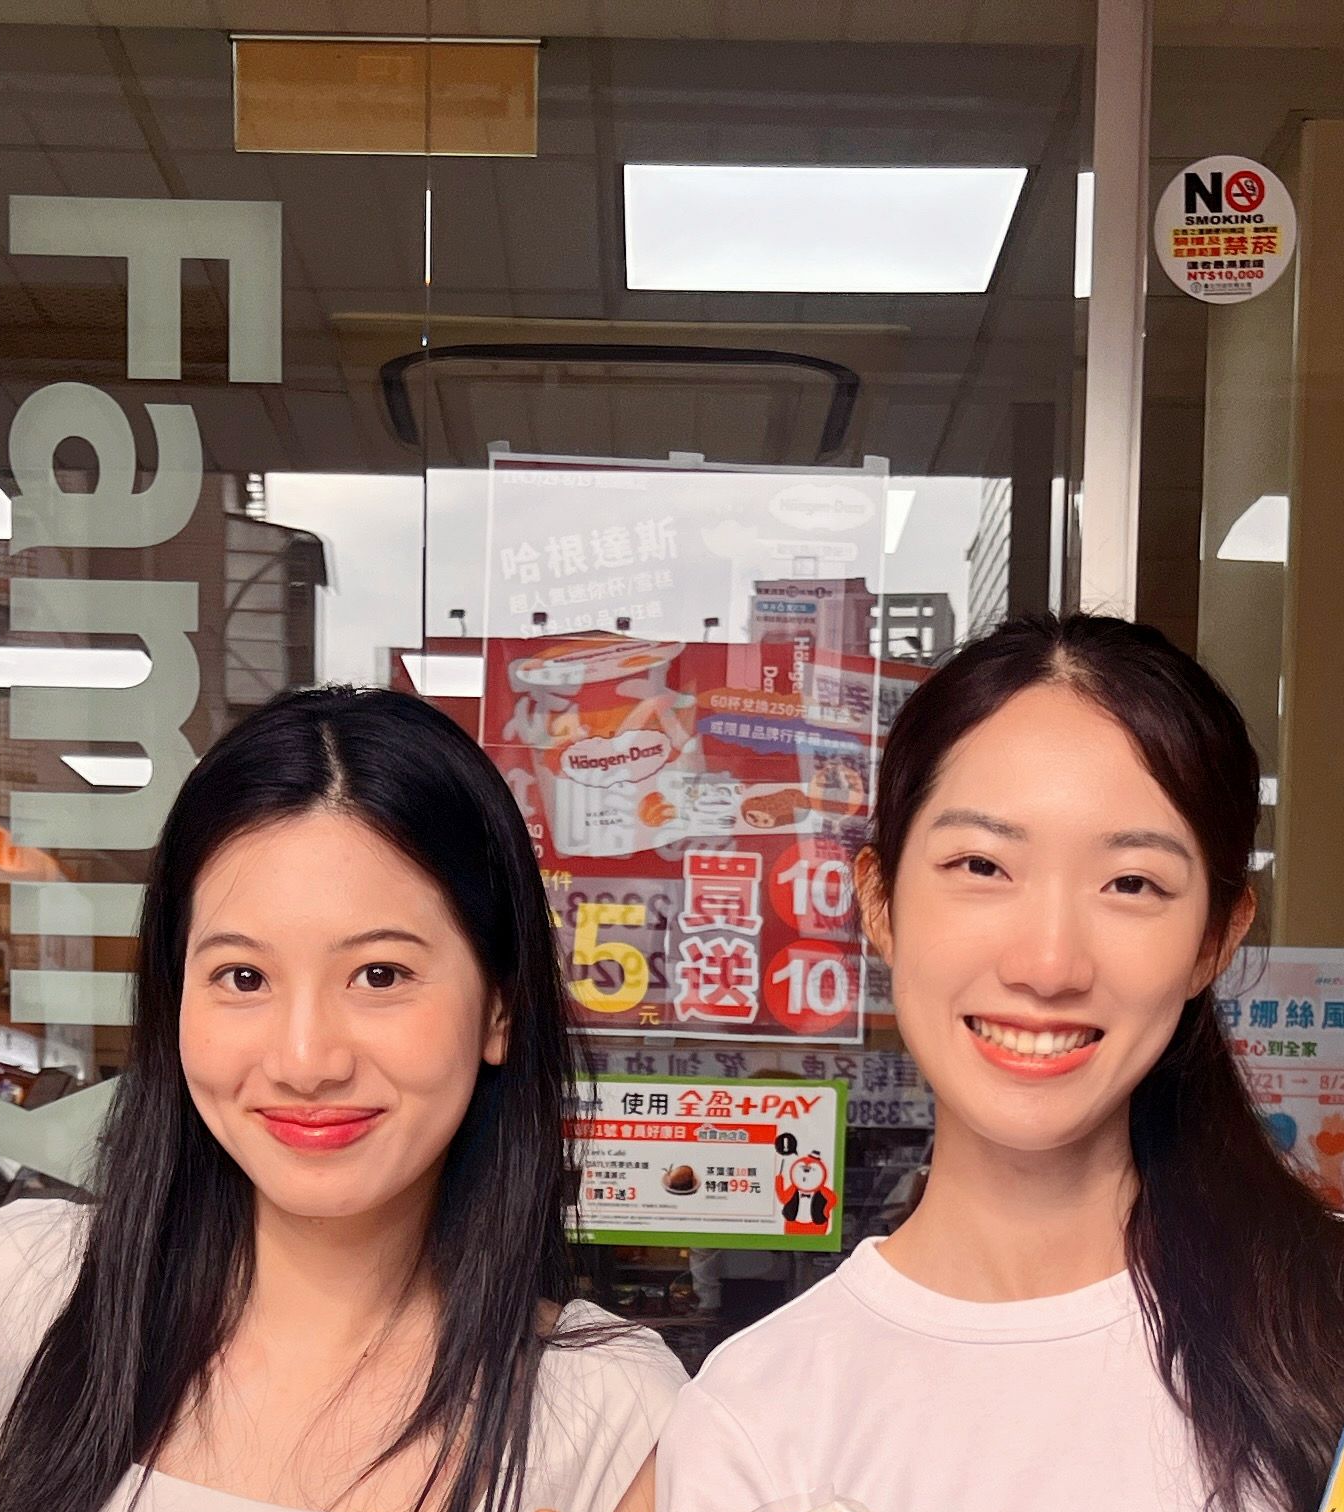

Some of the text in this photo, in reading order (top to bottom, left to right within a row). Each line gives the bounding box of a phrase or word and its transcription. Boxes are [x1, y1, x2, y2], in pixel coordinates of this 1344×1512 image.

[1185, 214, 1265, 225] SMOKING
[1224, 236, 1277, 255] 禁菸
[1187, 270, 1264, 281] NT$10,000
[499, 516, 679, 585] 哈根達斯
[568, 743, 664, 771] Häagen-Dazs
[680, 851, 762, 933] 買
[776, 859, 854, 918] 10
[569, 902, 649, 1013] 5
[638, 1004, 660, 1026] 元
[771, 958, 849, 1015] 10
[620, 1092, 669, 1116] 使用
[675, 1089, 823, 1119] 全盈+PAY
[705, 1179, 762, 1194] 特價99元
